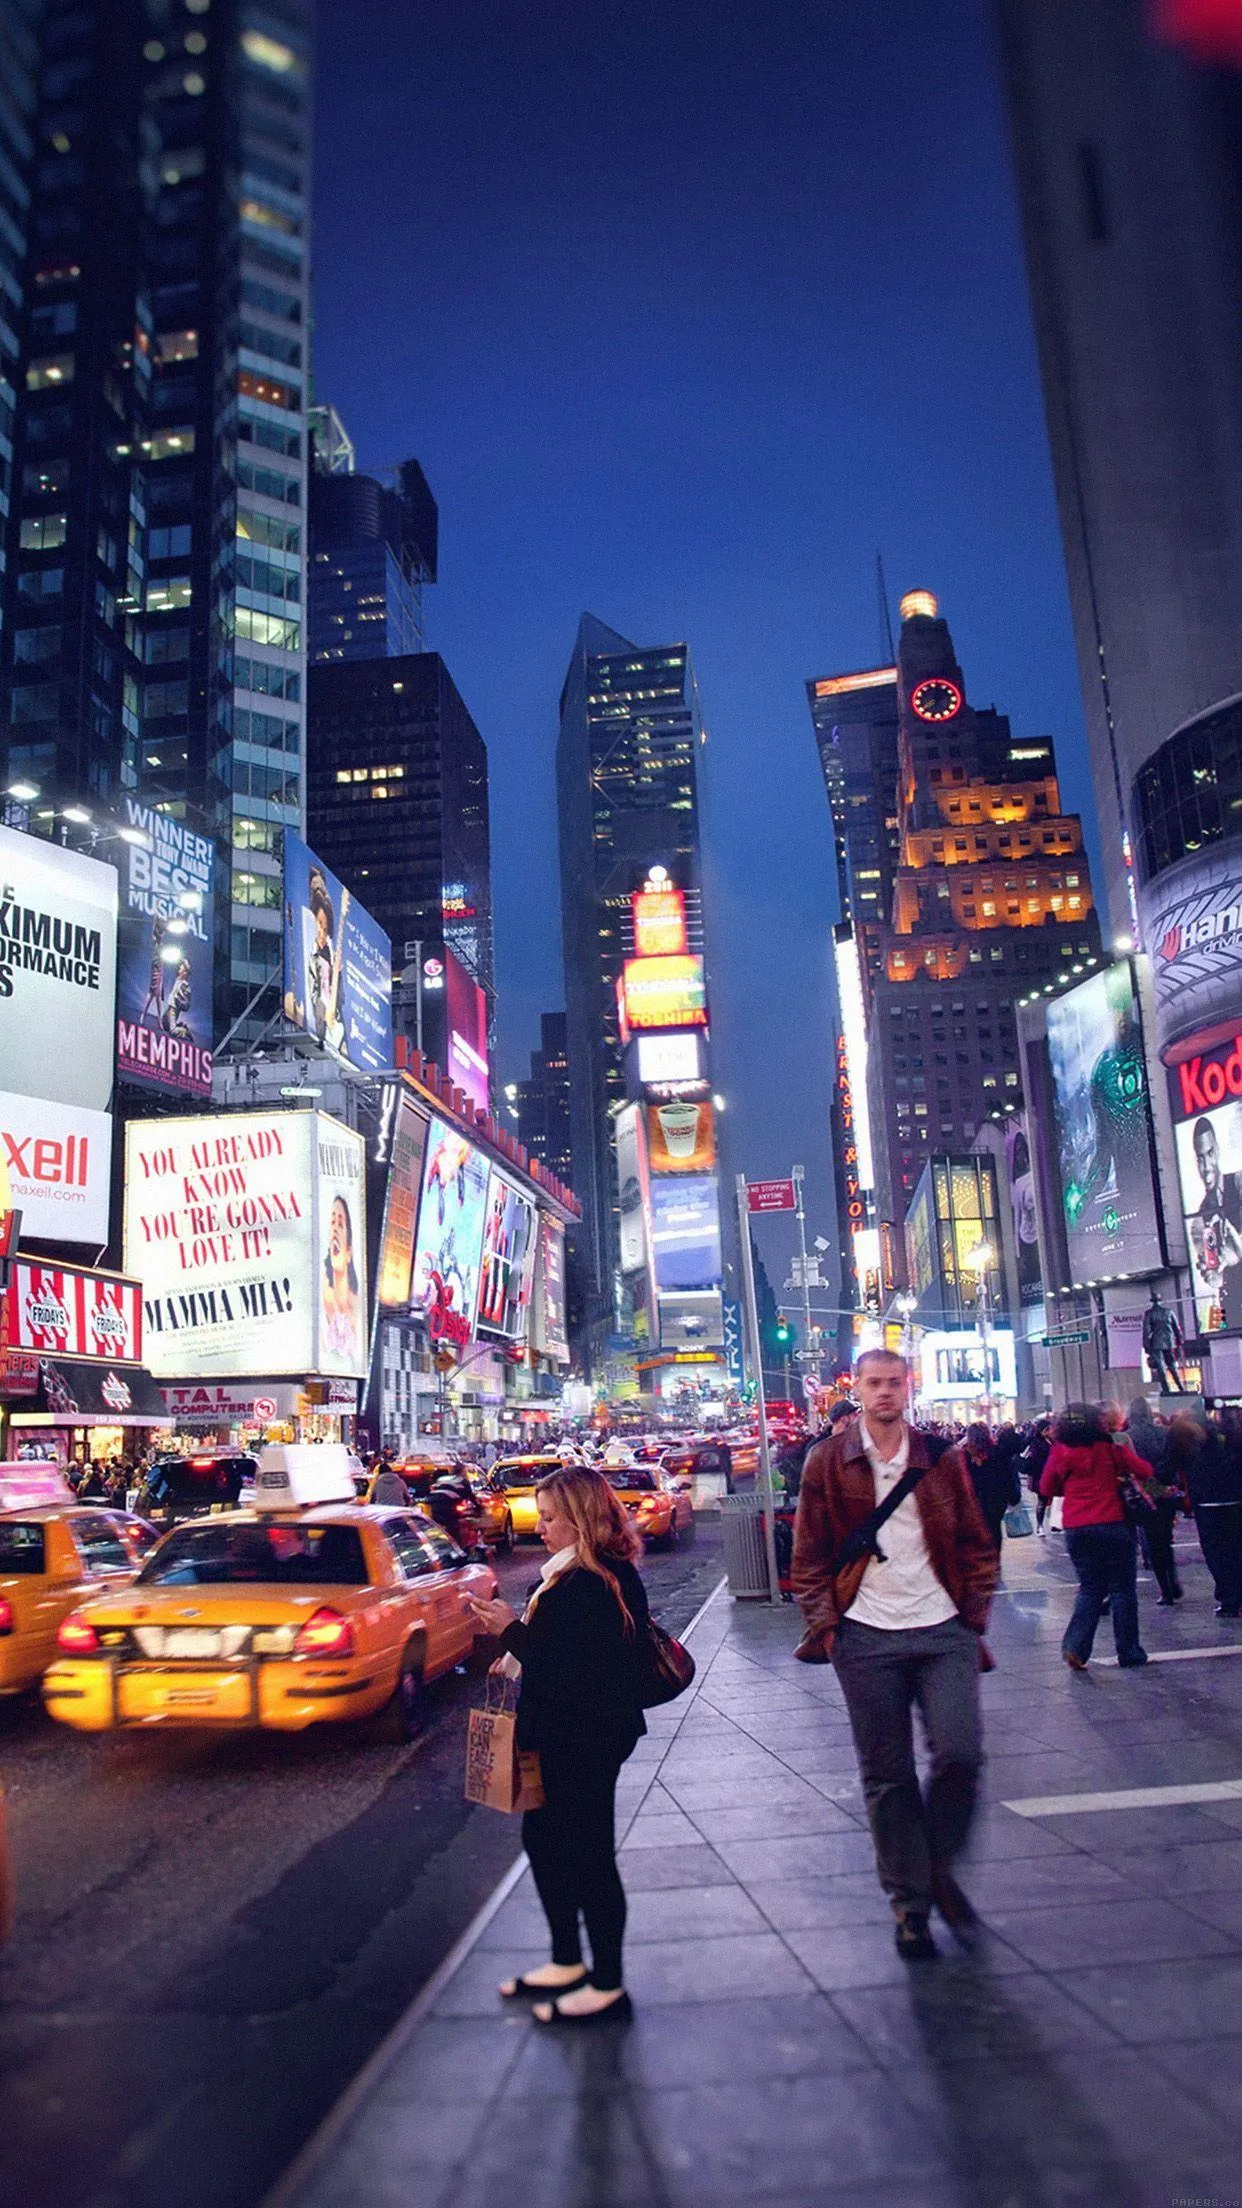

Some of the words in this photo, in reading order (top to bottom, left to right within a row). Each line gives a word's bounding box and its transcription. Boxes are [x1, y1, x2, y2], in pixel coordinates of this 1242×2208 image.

[126, 798, 213, 867] WINNER!
[129, 844, 209, 917] BEST
[128, 889, 209, 942] MUSICAL
[1180, 905, 1242, 952] Han
[628, 1007, 708, 1027] TOSHIBA
[118, 1019, 213, 1084] MEMPHIS
[139, 1147, 179, 1179] YOU
[190, 1128, 284, 1171] ALREADY
[183, 1165, 248, 1204] KNOW
[750, 1186, 760, 1194] NO
[761, 1183, 790, 1192] STOPPING
[758, 1192, 784, 1201] ANYTIME
[140, 1203, 221, 1243] YOU'RE
[226, 1190, 302, 1230] GONNA
[178, 1233, 237, 1270] LOVE
[240, 1226, 272, 1260] IT!
[32, 1305, 65, 1326] FRIDAYS
[96, 1317, 124, 1334] FRIDAYS
[144, 1288, 234, 1334] MAMMA
[239, 1277, 293, 1320] MIA!
[170, 1402, 255, 1415] COMPUTERS
